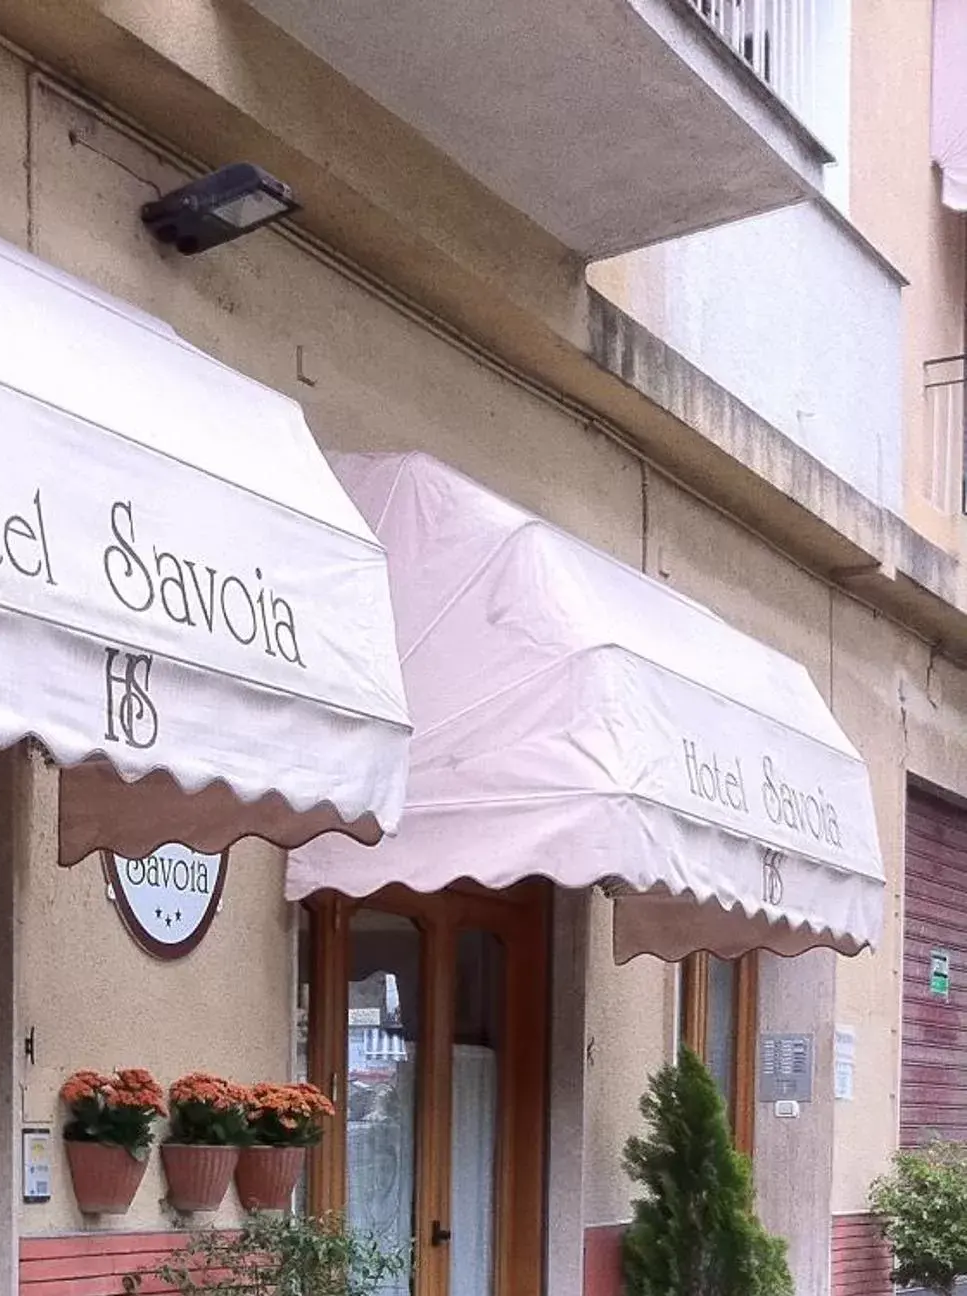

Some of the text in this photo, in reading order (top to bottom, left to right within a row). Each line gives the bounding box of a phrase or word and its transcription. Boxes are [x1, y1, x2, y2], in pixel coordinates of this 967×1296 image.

[103, 500, 307, 669] Savoia
[682, 738, 843, 849] Hotel Savoia
